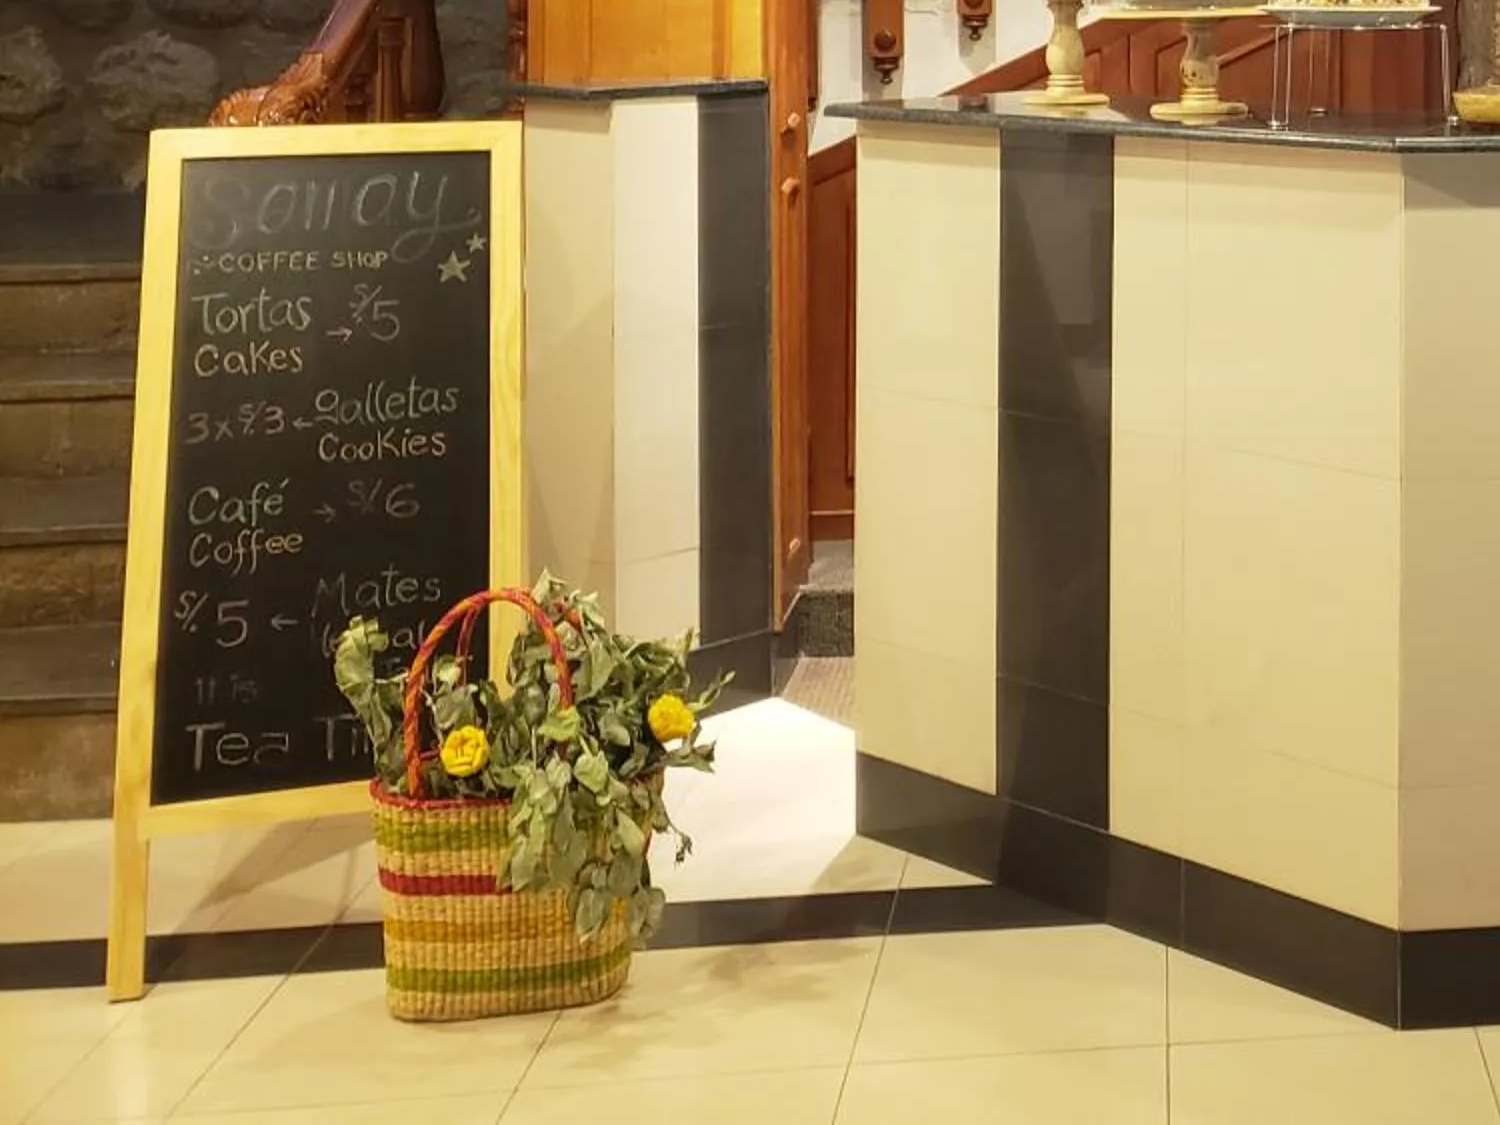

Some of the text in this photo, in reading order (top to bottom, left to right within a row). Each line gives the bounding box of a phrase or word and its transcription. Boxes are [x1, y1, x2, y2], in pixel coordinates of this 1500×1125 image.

[218, 250, 389, 274] COFFEE SHOP
[191, 288, 312, 337] Tortas
[193, 340, 304, 377] Cakes
[188, 479, 289, 527] Café
[188, 528, 304, 574] Coffee
[311, 563, 442, 617] Mates
[185, 721, 289, 771] Tea
